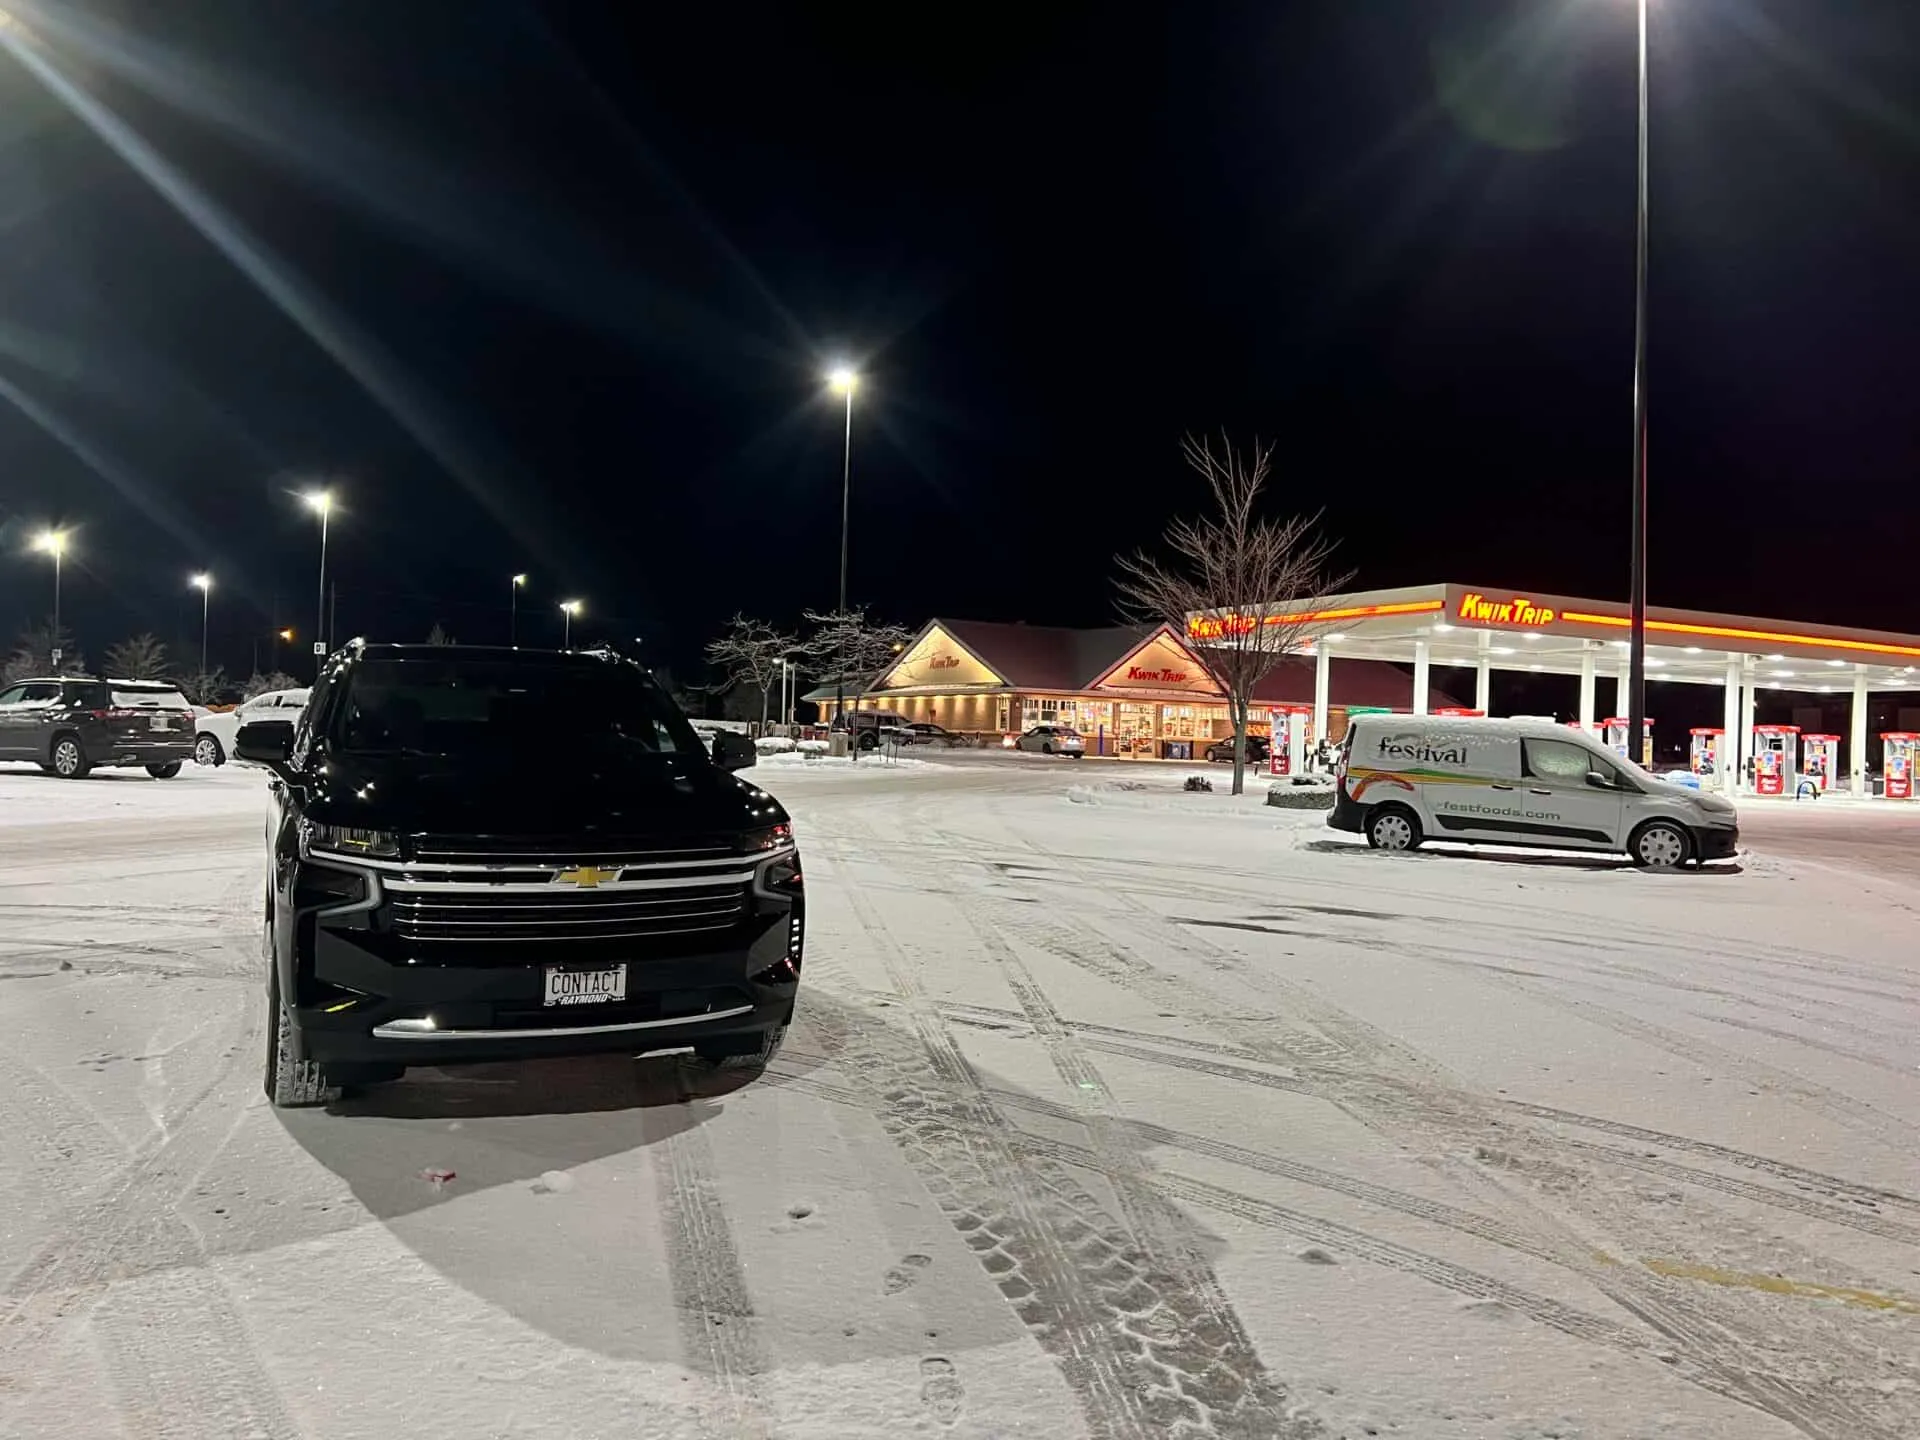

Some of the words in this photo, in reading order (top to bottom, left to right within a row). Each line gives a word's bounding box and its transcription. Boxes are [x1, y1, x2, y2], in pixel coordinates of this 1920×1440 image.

[1378, 737, 1467, 764] festival
[1443, 802, 1561, 821] festfoods.com
[552, 972, 620, 994] CONTACT
[561, 994, 608, 1005] RAYMOND
